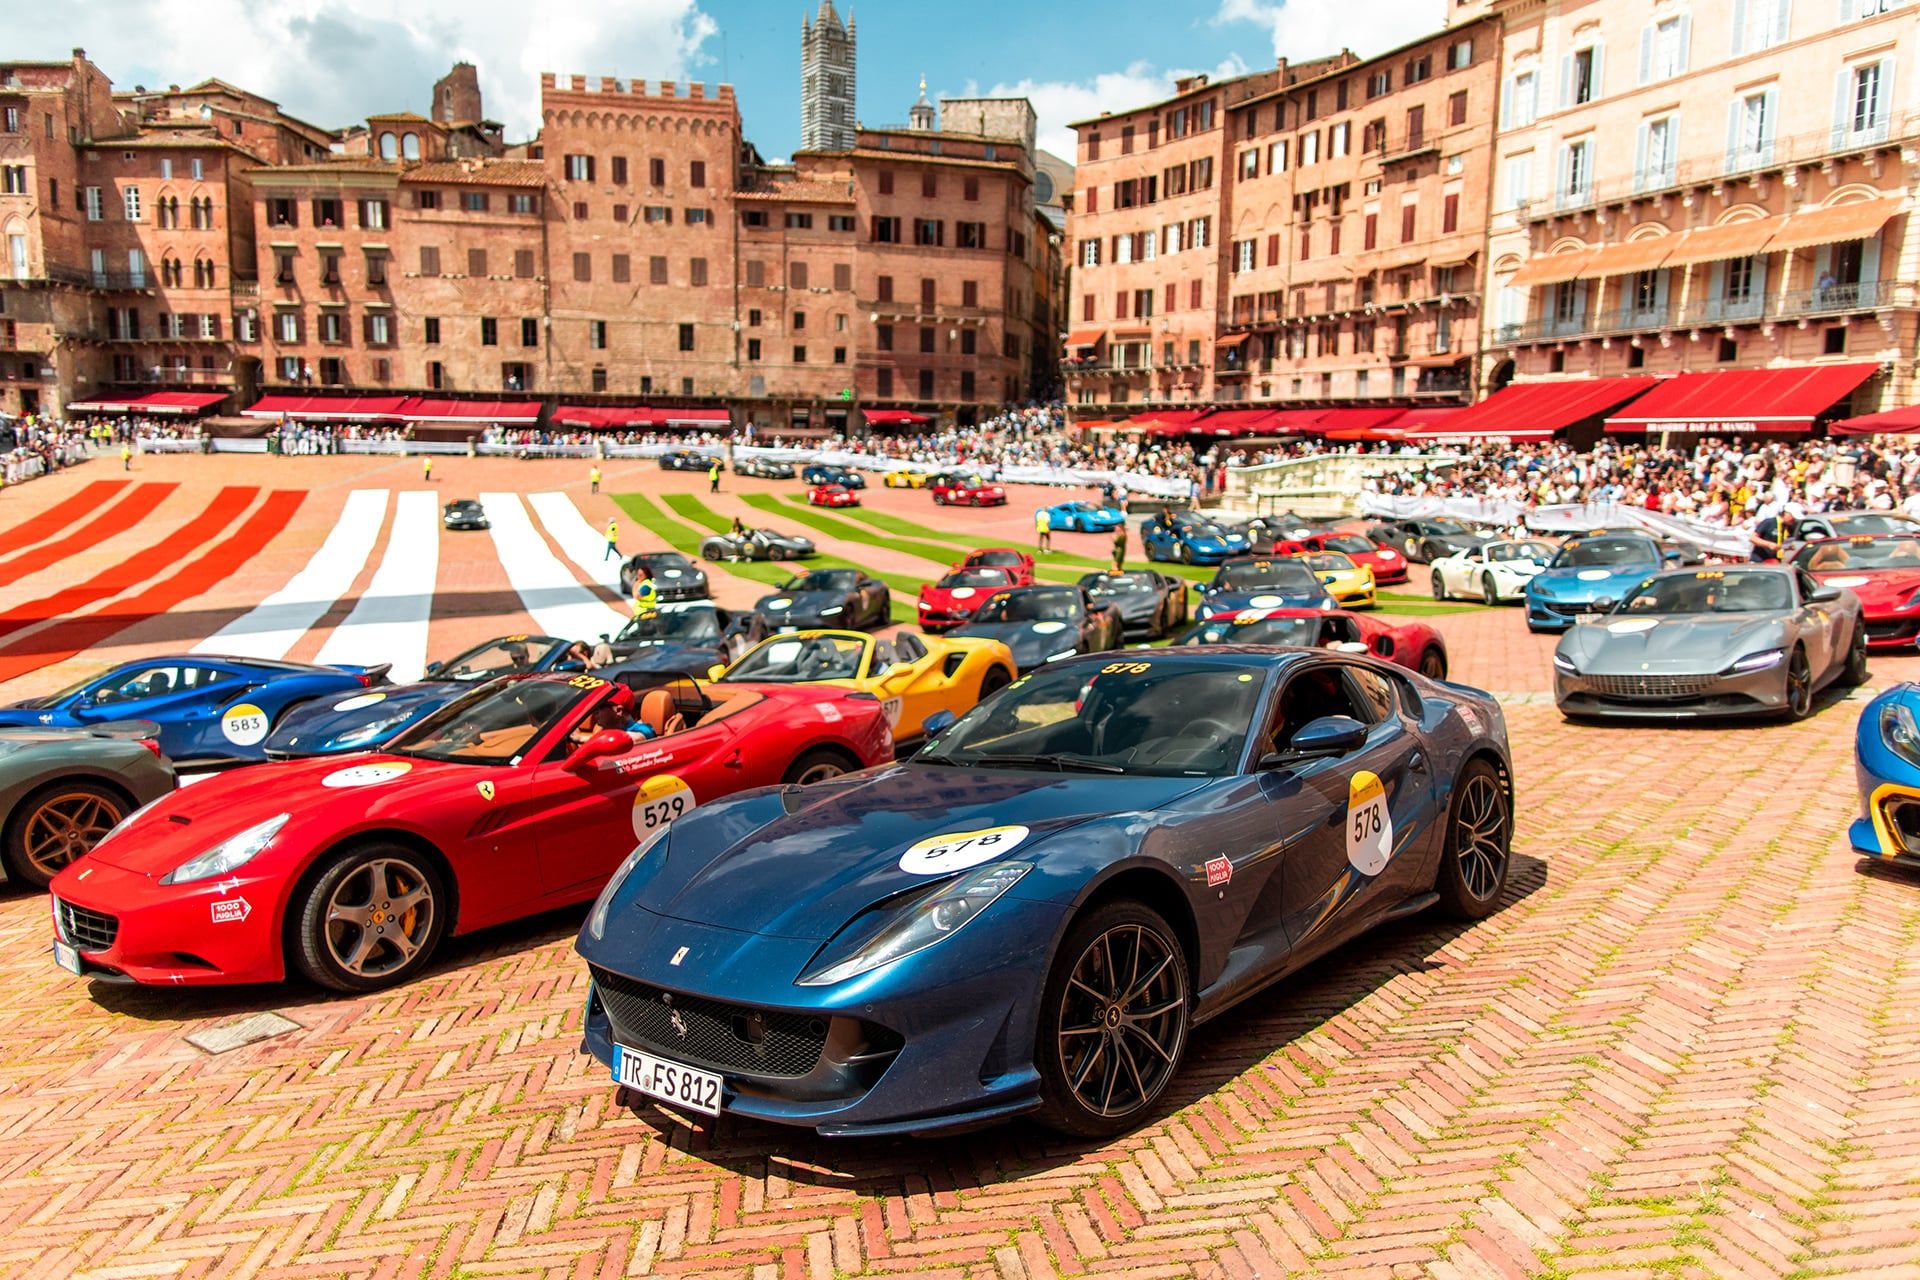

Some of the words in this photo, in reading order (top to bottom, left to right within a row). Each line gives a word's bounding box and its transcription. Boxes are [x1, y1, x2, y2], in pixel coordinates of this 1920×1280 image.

[1101, 662, 1152, 675] 578
[568, 674, 605, 690] 529
[231, 717, 260, 732] 583
[644, 797, 684, 828] 529
[1354, 803, 1381, 843] 578
[925, 834, 1002, 859] 578
[1209, 861, 1225, 872] 1000
[1210, 871, 1228, 883] MIGLIA
[216, 902, 240, 912] 1000
[215, 910, 242, 920] MIGLIA
[623, 1052, 642, 1086] TR
[653, 1063, 677, 1097] FS
[680, 1072, 718, 1110] 812
